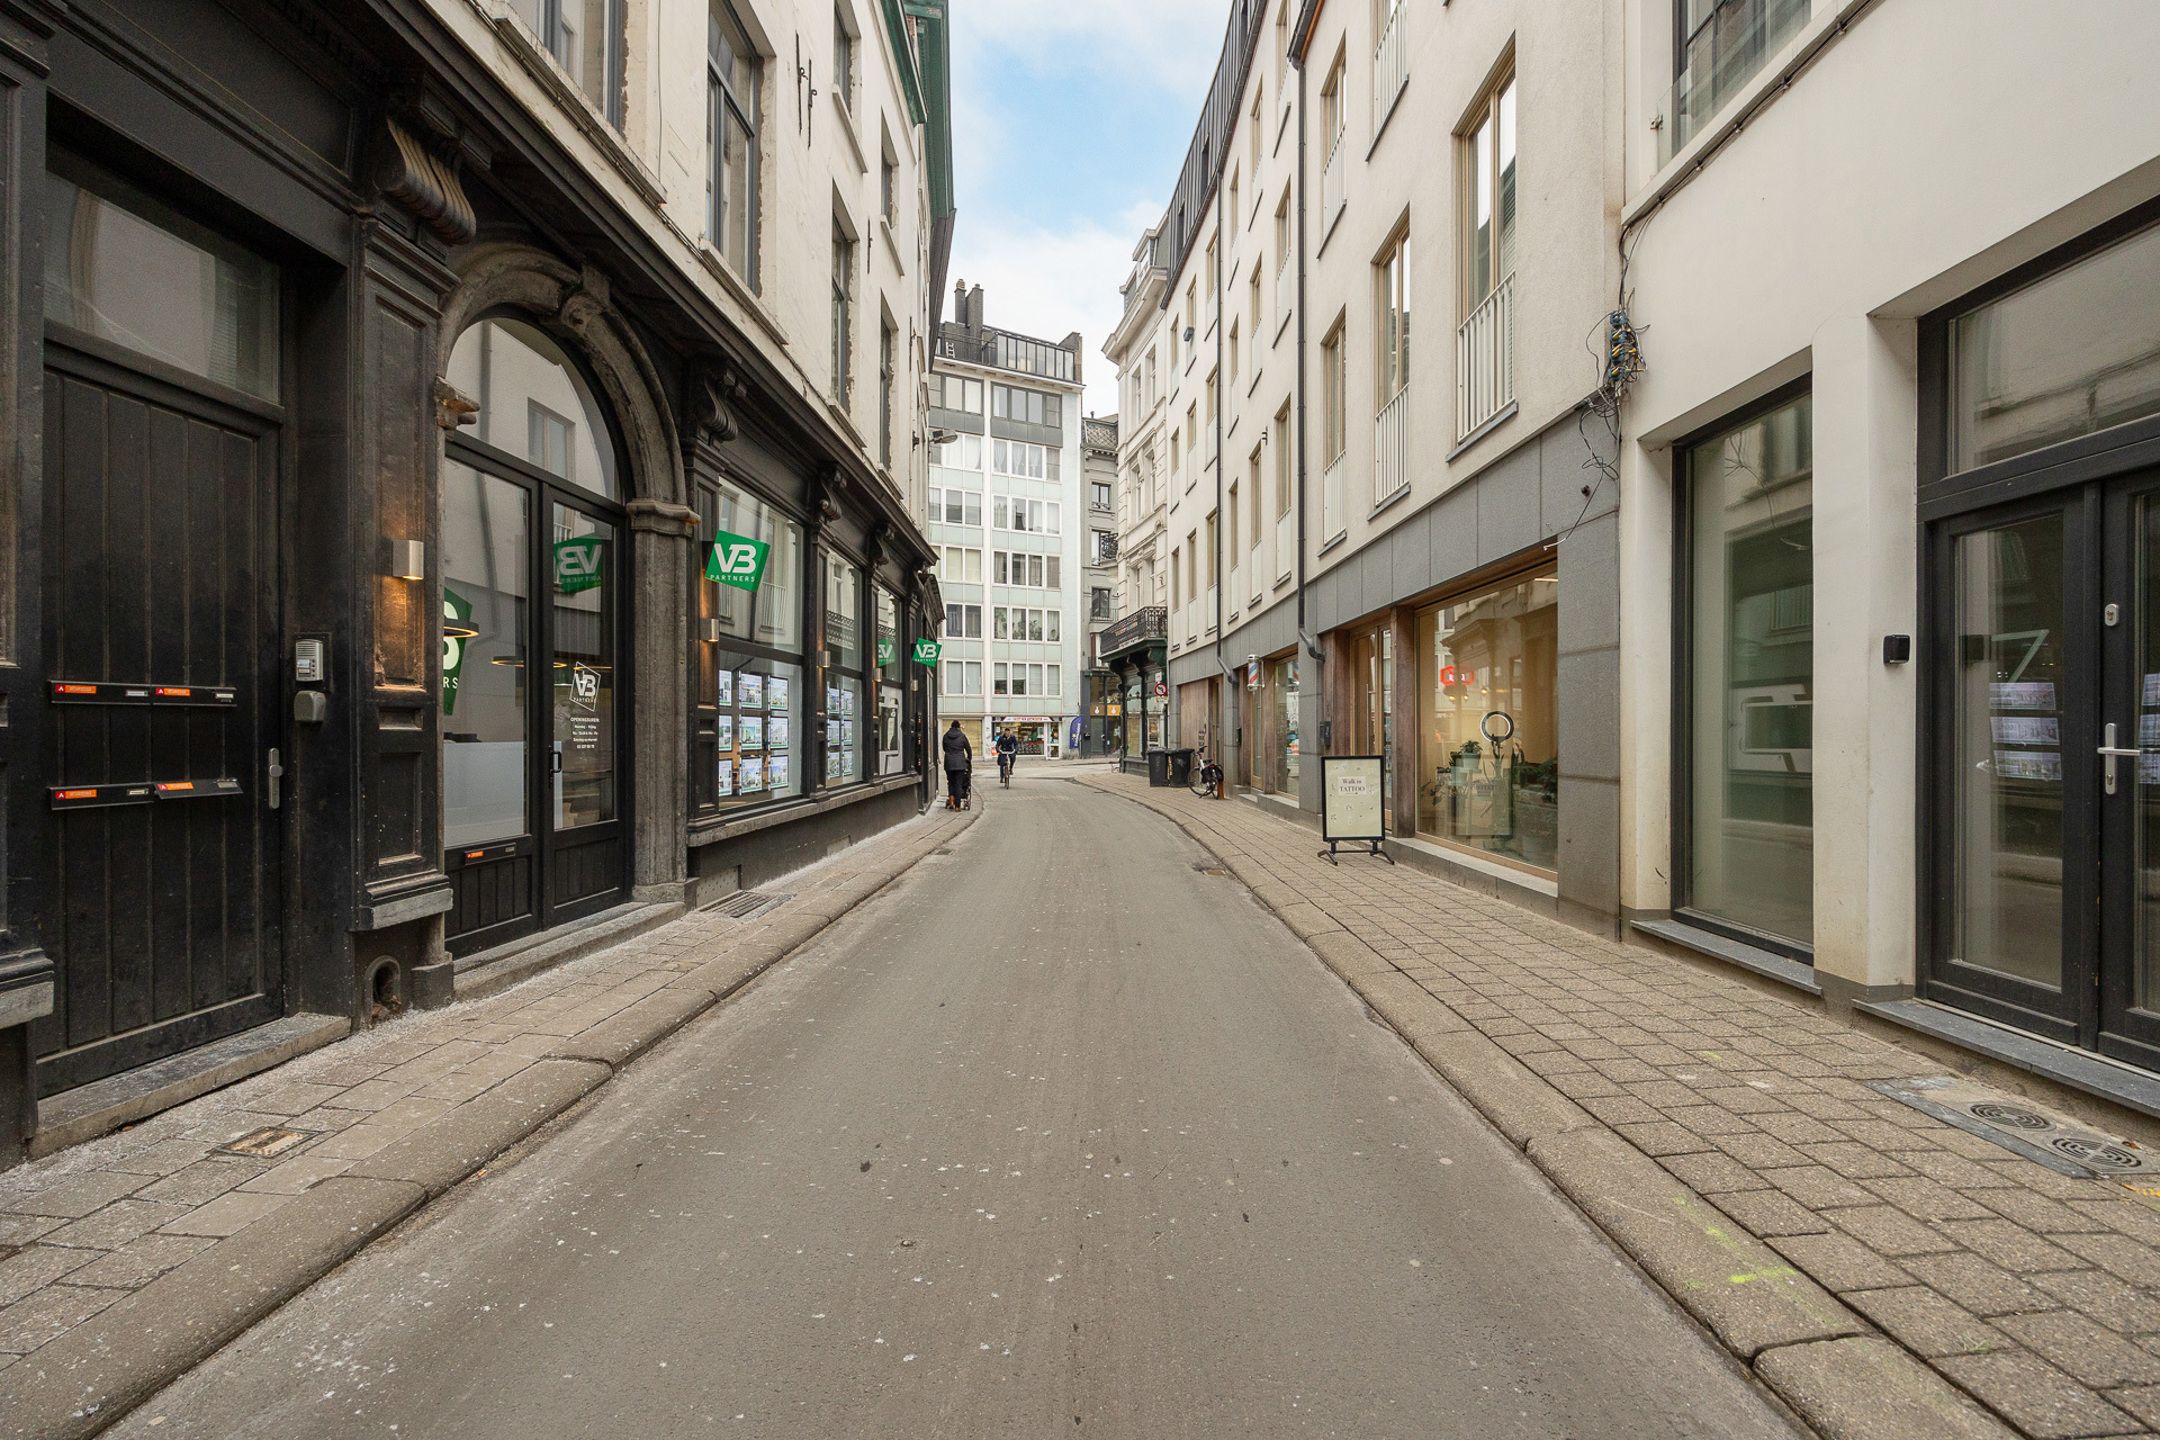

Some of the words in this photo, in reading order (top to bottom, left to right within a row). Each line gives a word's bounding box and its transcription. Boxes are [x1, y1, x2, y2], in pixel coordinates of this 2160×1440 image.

[713, 543, 757, 574] VB
[710, 574, 756, 582] PARTNERS
[916, 643, 937, 659] VB
